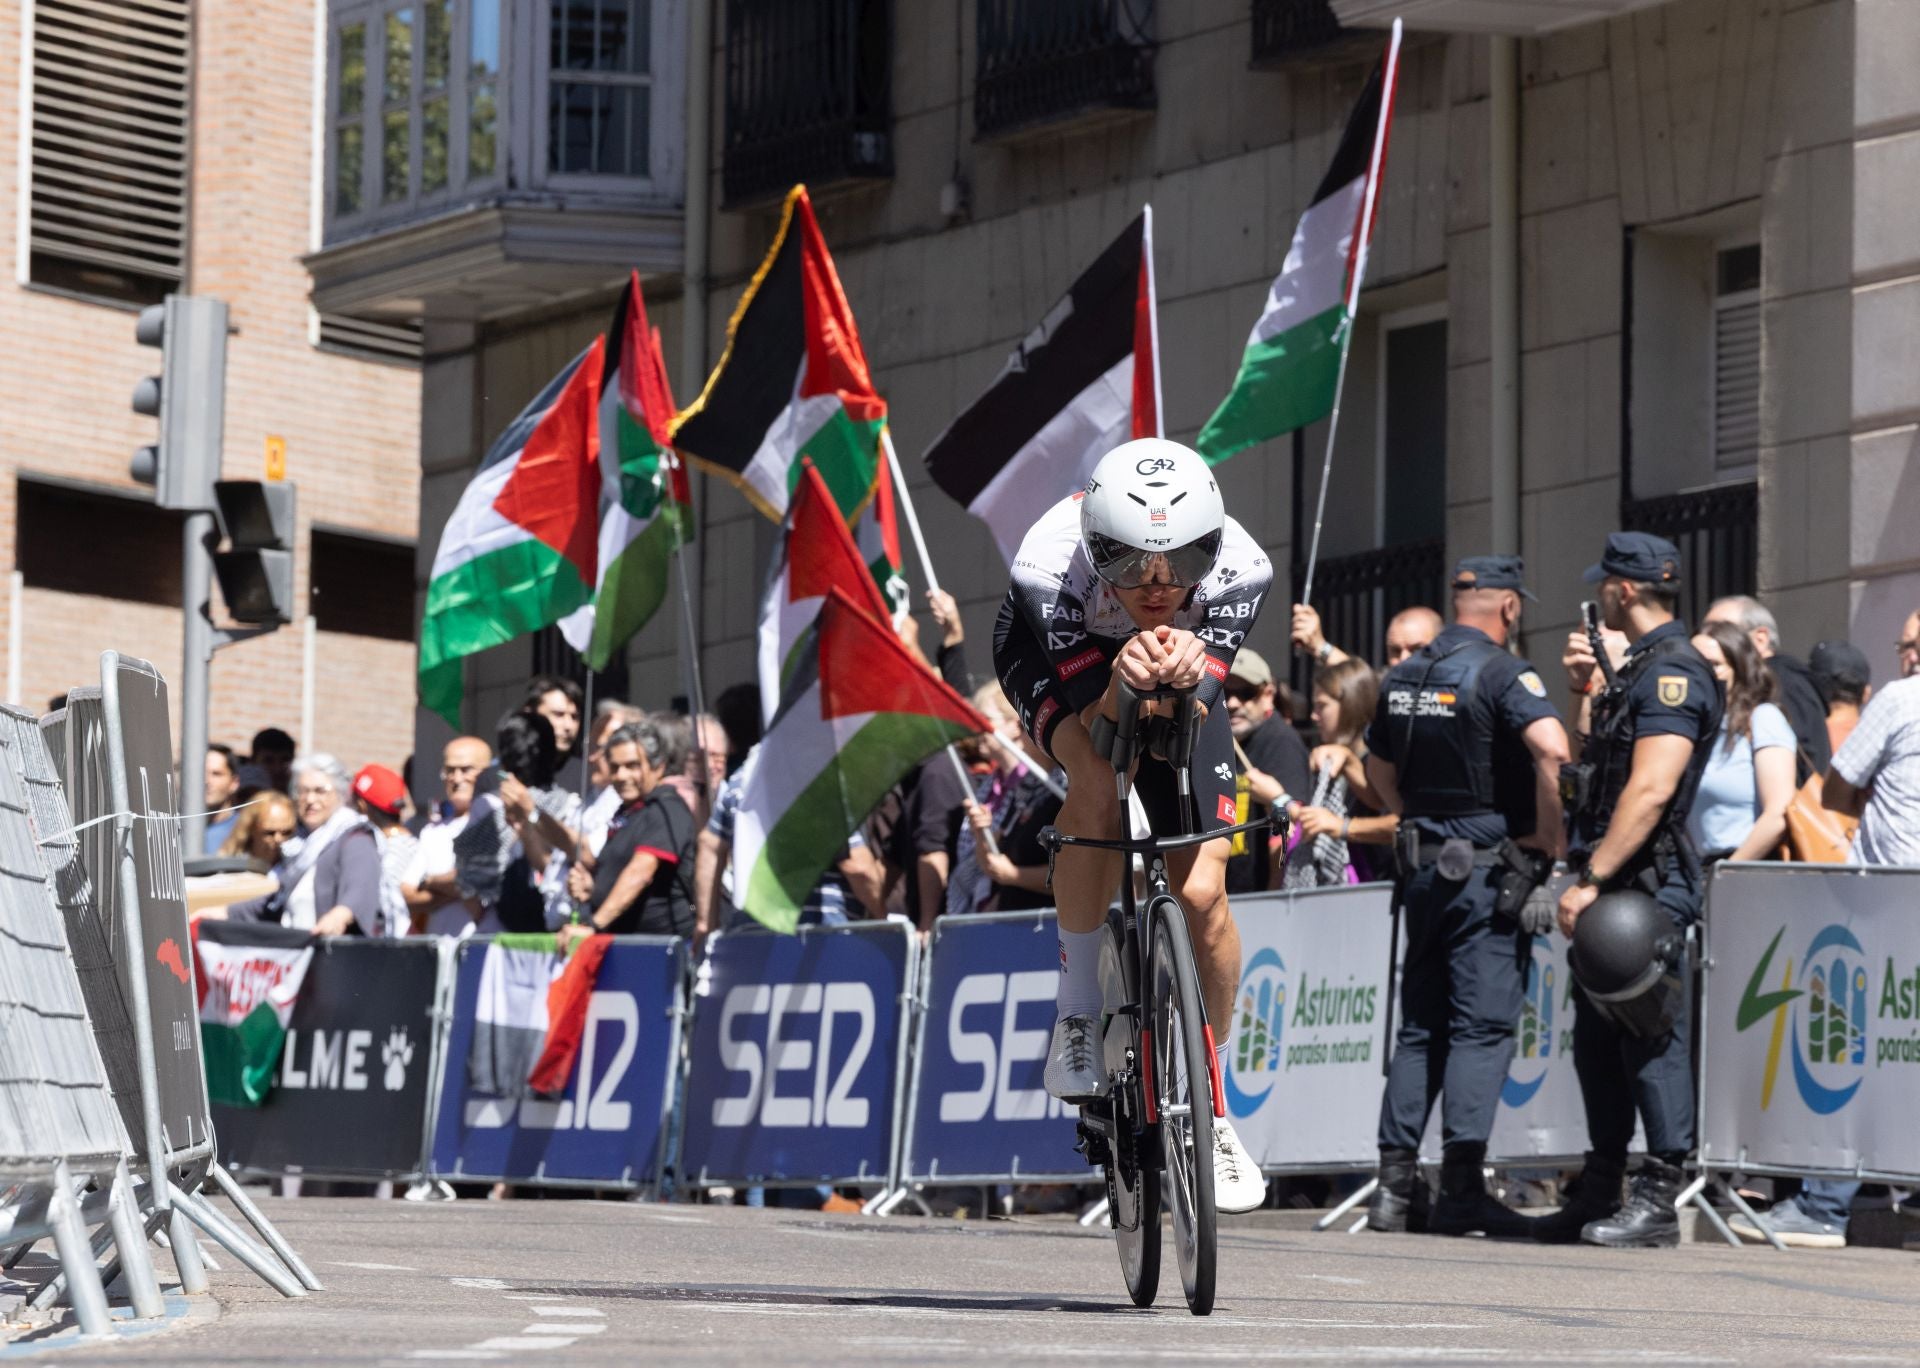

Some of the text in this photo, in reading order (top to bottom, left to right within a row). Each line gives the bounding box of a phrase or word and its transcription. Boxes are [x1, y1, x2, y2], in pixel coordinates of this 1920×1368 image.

[1136, 458, 1176, 476] G42
[1145, 537, 1173, 546] MET
[1060, 650, 1103, 676] Emirates
[1291, 972, 1377, 1028] Asturias
[712, 982, 876, 1127] SER
[940, 970, 1080, 1123] SE
[1286, 1034, 1373, 1073] paraíso natural
